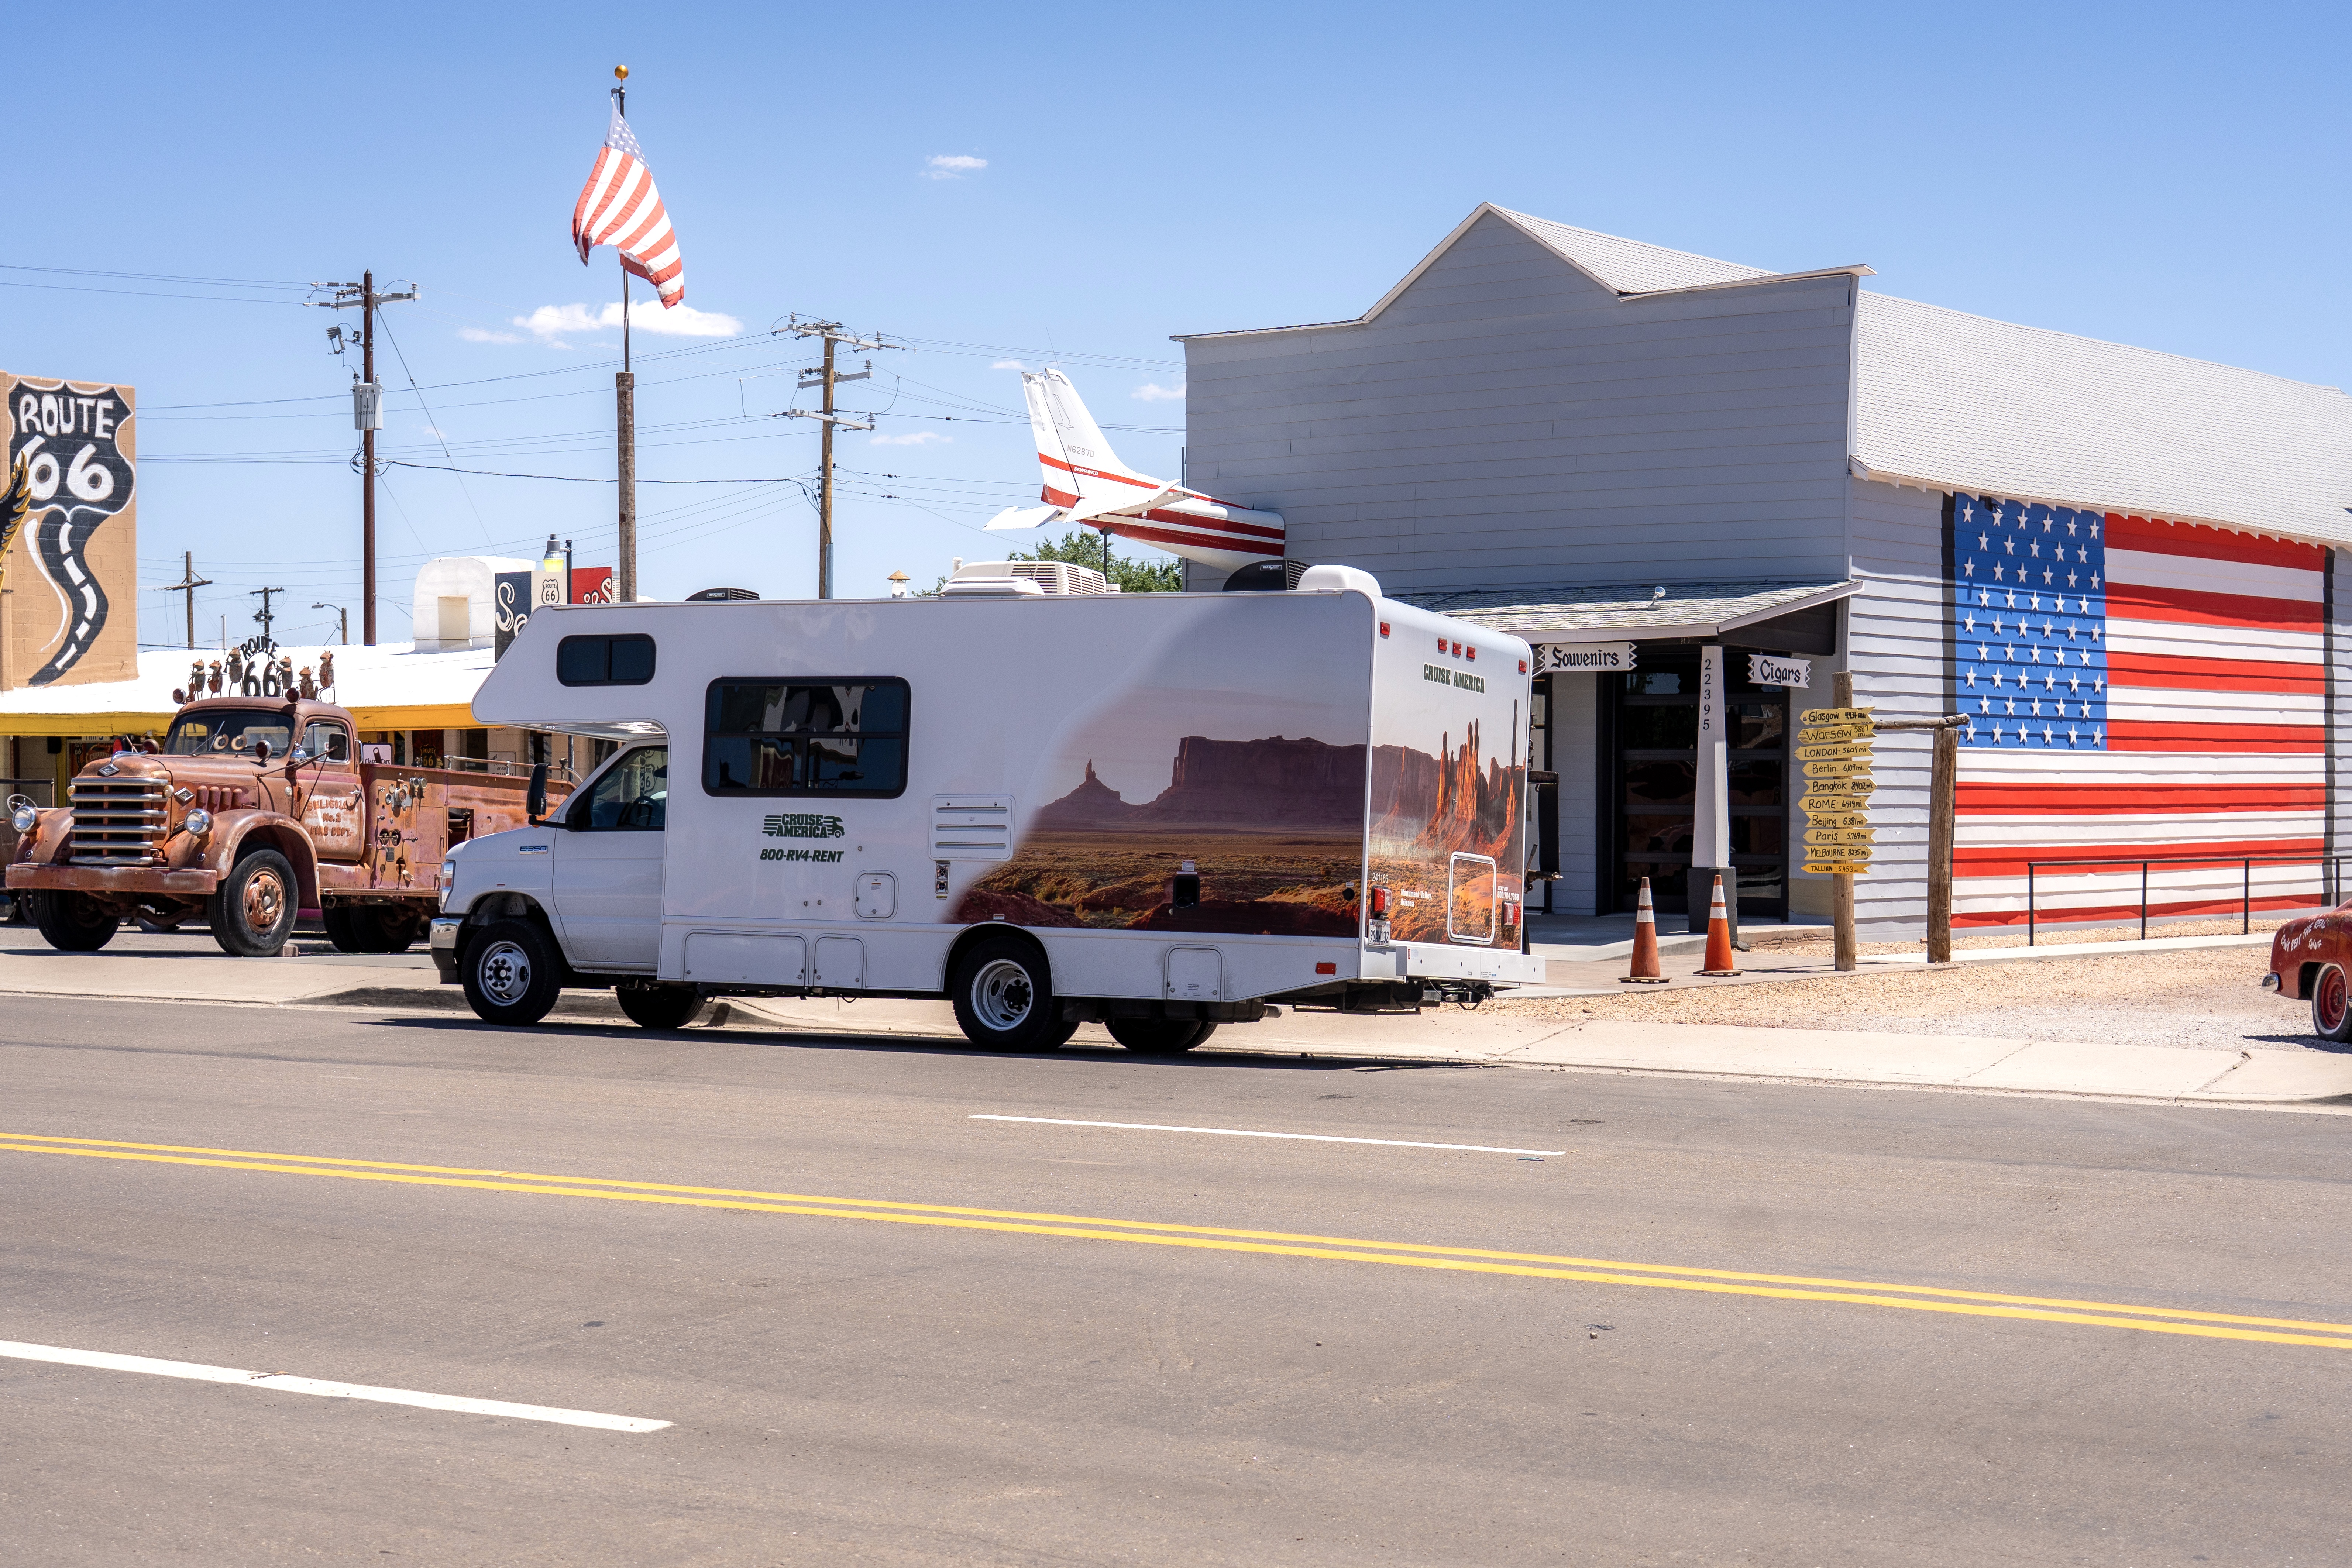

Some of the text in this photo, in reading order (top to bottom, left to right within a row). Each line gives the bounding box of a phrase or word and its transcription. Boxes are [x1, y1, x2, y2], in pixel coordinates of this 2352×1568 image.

[20, 393, 114, 439] ROUTE
[1067, 444, 1094, 457] N6267D
[16, 435, 114, 501] 66
[1074, 467, 1094, 475] SKYHAWK
[546, 590, 555, 601] 66
[240, 636, 279, 660] ROUTE
[1550, 646, 1619, 669] Souvenirs
[1760, 659, 1801, 684] Cigars
[243, 661, 281, 697] 66
[1423, 664, 1485, 694] CRUISE AMERICA
[1806, 729, 1852, 741] Warsaw
[423, 755, 433, 767] 66
[1812, 764, 1836, 774] Berlin
[640, 776, 651, 788] 66
[1813, 781, 1847, 792] Bangkok
[1809, 799, 1836, 809] ROME
[782, 814, 823, 826] CRUISE
[1812, 815, 1836, 827] Beijing
[310, 826, 329, 836] FIRE
[776, 825, 828, 838] AMERICA
[1816, 831, 1838, 840] Paris
[760, 849, 845, 862] 800-RV4-RENT
[1811, 847, 1845, 857] MELBOURNE
[1372, 872, 1388, 883] 241166
[1401, 889, 1420, 898] Monument
[1400, 898, 1414, 907] Arizona
[2291, 933, 2302, 952] BEAT
[2303, 922, 2314, 939] THE
[2308, 938, 2322, 950] THING
